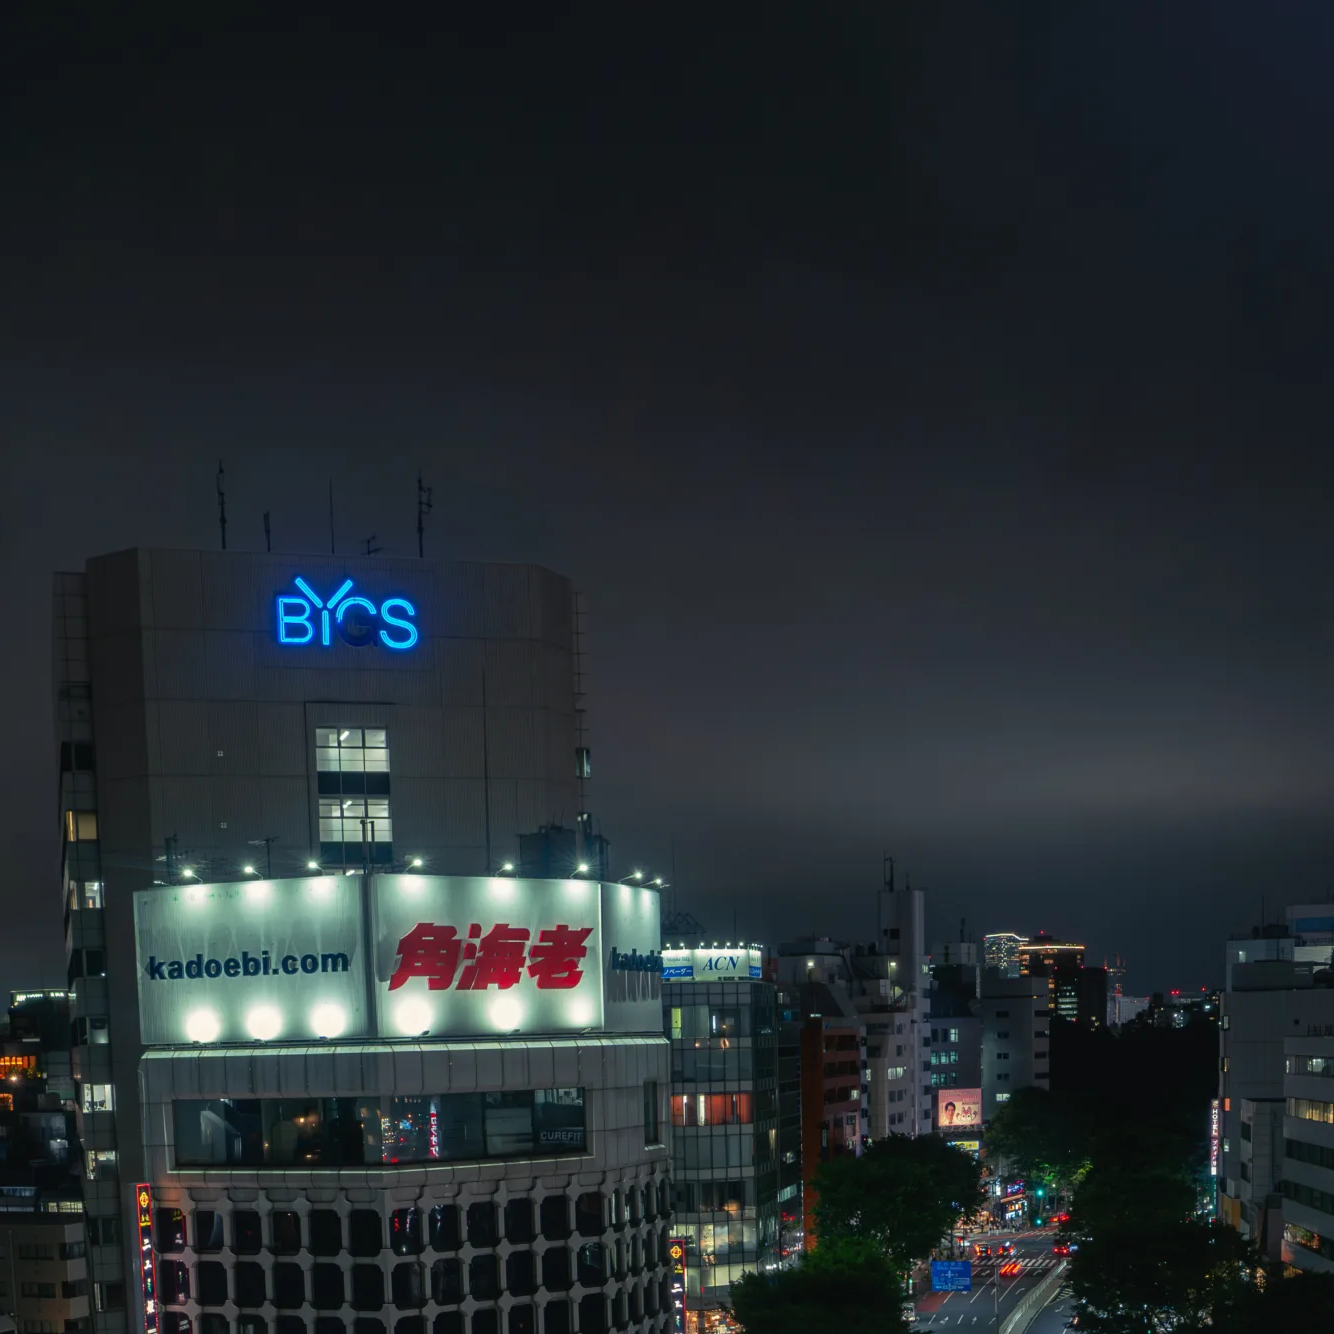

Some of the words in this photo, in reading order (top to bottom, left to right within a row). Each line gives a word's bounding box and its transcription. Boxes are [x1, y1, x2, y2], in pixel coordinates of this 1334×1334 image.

[148, 950, 350, 980] kadoebi.com
[388, 922, 595, 992] 角海老
[702, 956, 740, 971] ACN
[540, 1130, 582, 1141] CUREFIT
